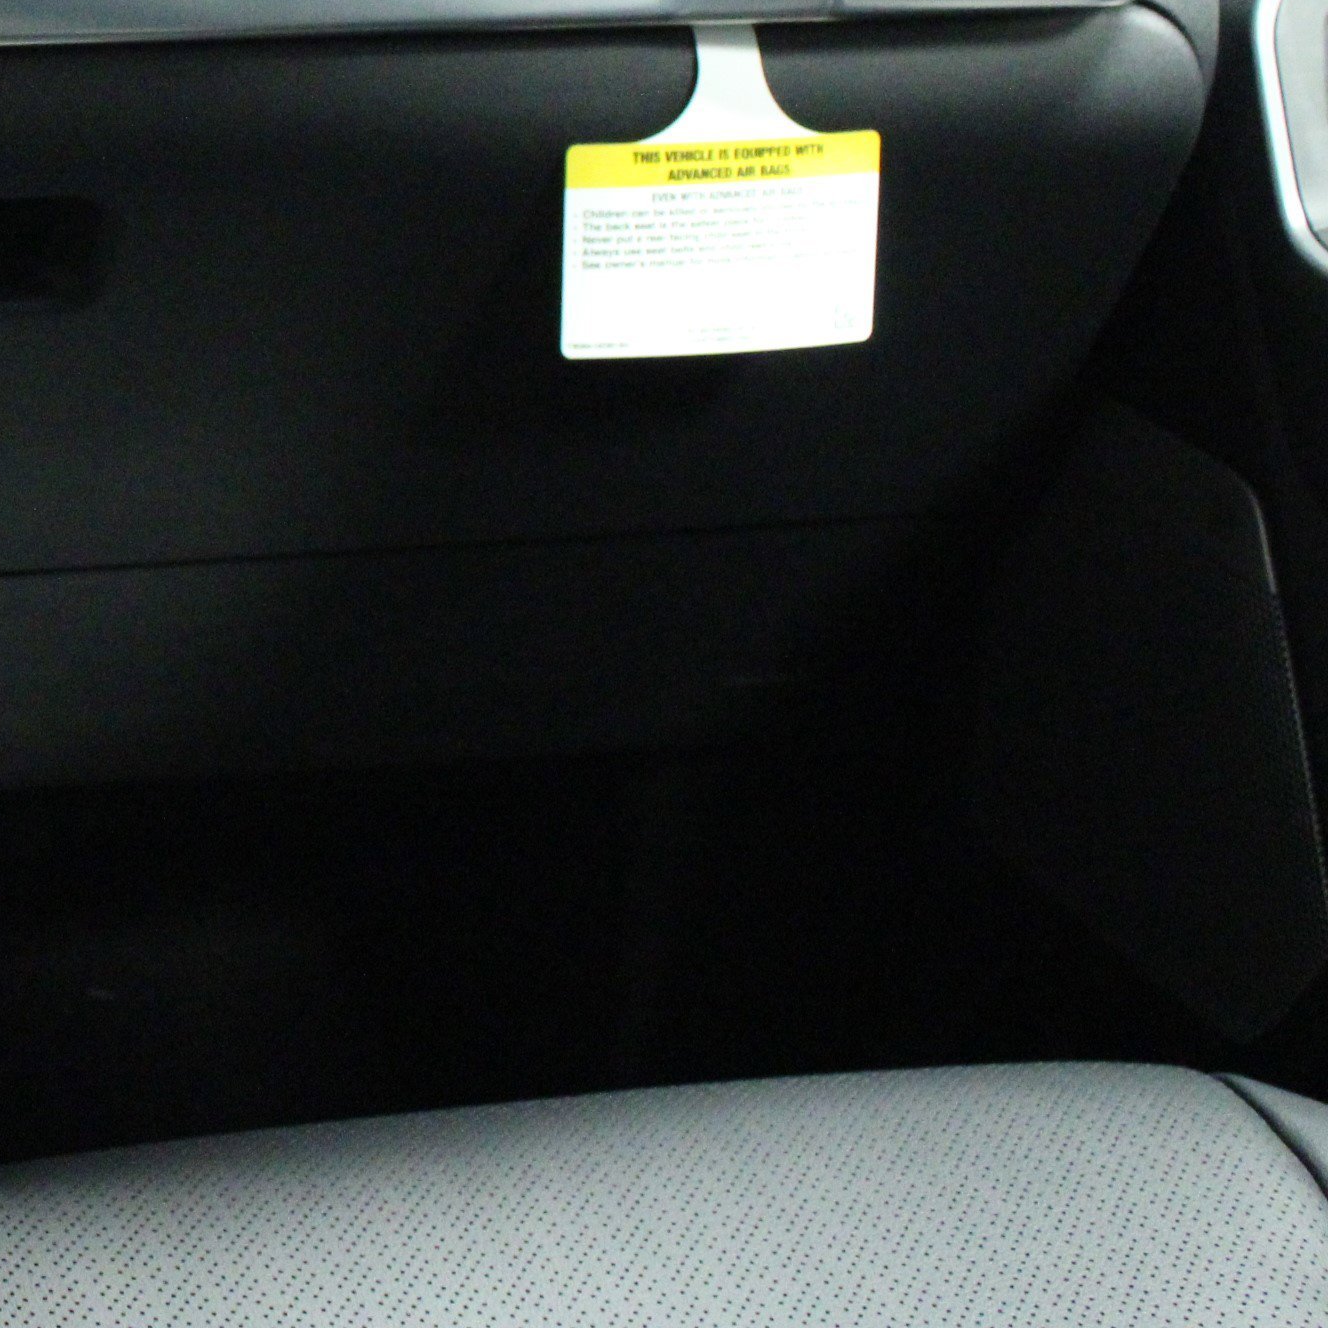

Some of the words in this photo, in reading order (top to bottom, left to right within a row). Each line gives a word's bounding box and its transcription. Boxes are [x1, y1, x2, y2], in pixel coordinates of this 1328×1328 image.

[633, 151, 660, 164] THIS
[664, 149, 714, 163] VEHICLE
[719, 148, 730, 160] IS
[734, 146, 791, 160] EQUIPPED
[795, 143, 824, 155] WITH
[668, 167, 732, 181] ADVANCED
[737, 165, 756, 177] AIR
[760, 164, 790, 176] BAGS
